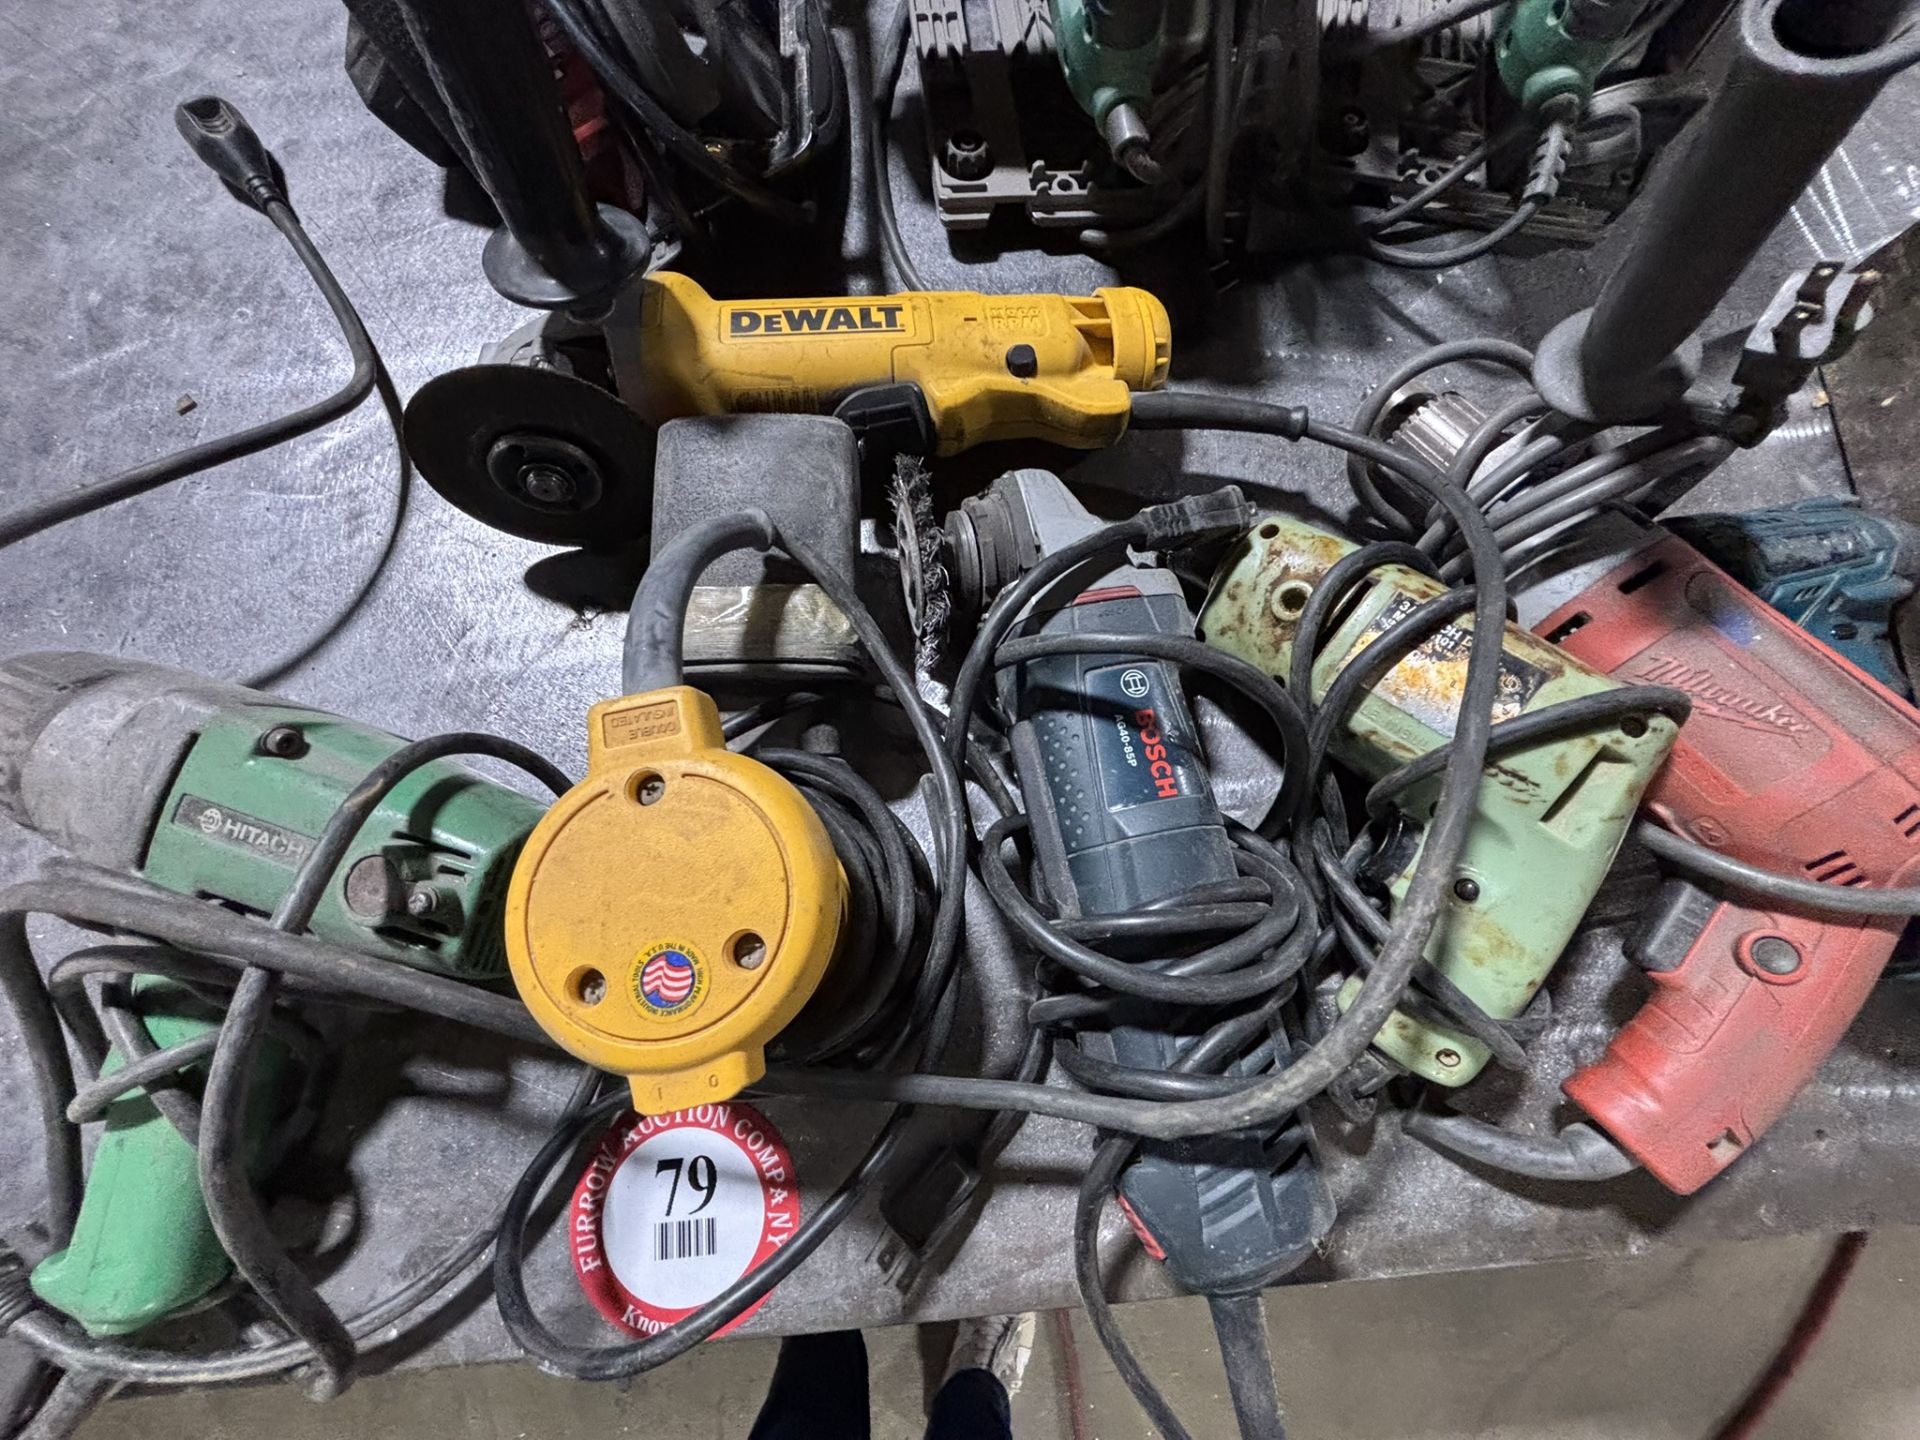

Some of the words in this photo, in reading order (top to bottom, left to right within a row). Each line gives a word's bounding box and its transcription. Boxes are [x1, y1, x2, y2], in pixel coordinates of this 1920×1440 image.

[731, 307, 904, 333] DEWALT
[628, 721, 677, 740] DOUBLE
[1114, 714, 1138, 768] AG40-85P
[1135, 708, 1179, 798] BOSCH
[221, 818, 307, 859] HITACH
[577, 1142, 618, 1274] FURROW
[622, 1104, 731, 1151] AUCTION
[734, 1118, 794, 1248] COMPANY
[655, 1154, 718, 1217] 79
